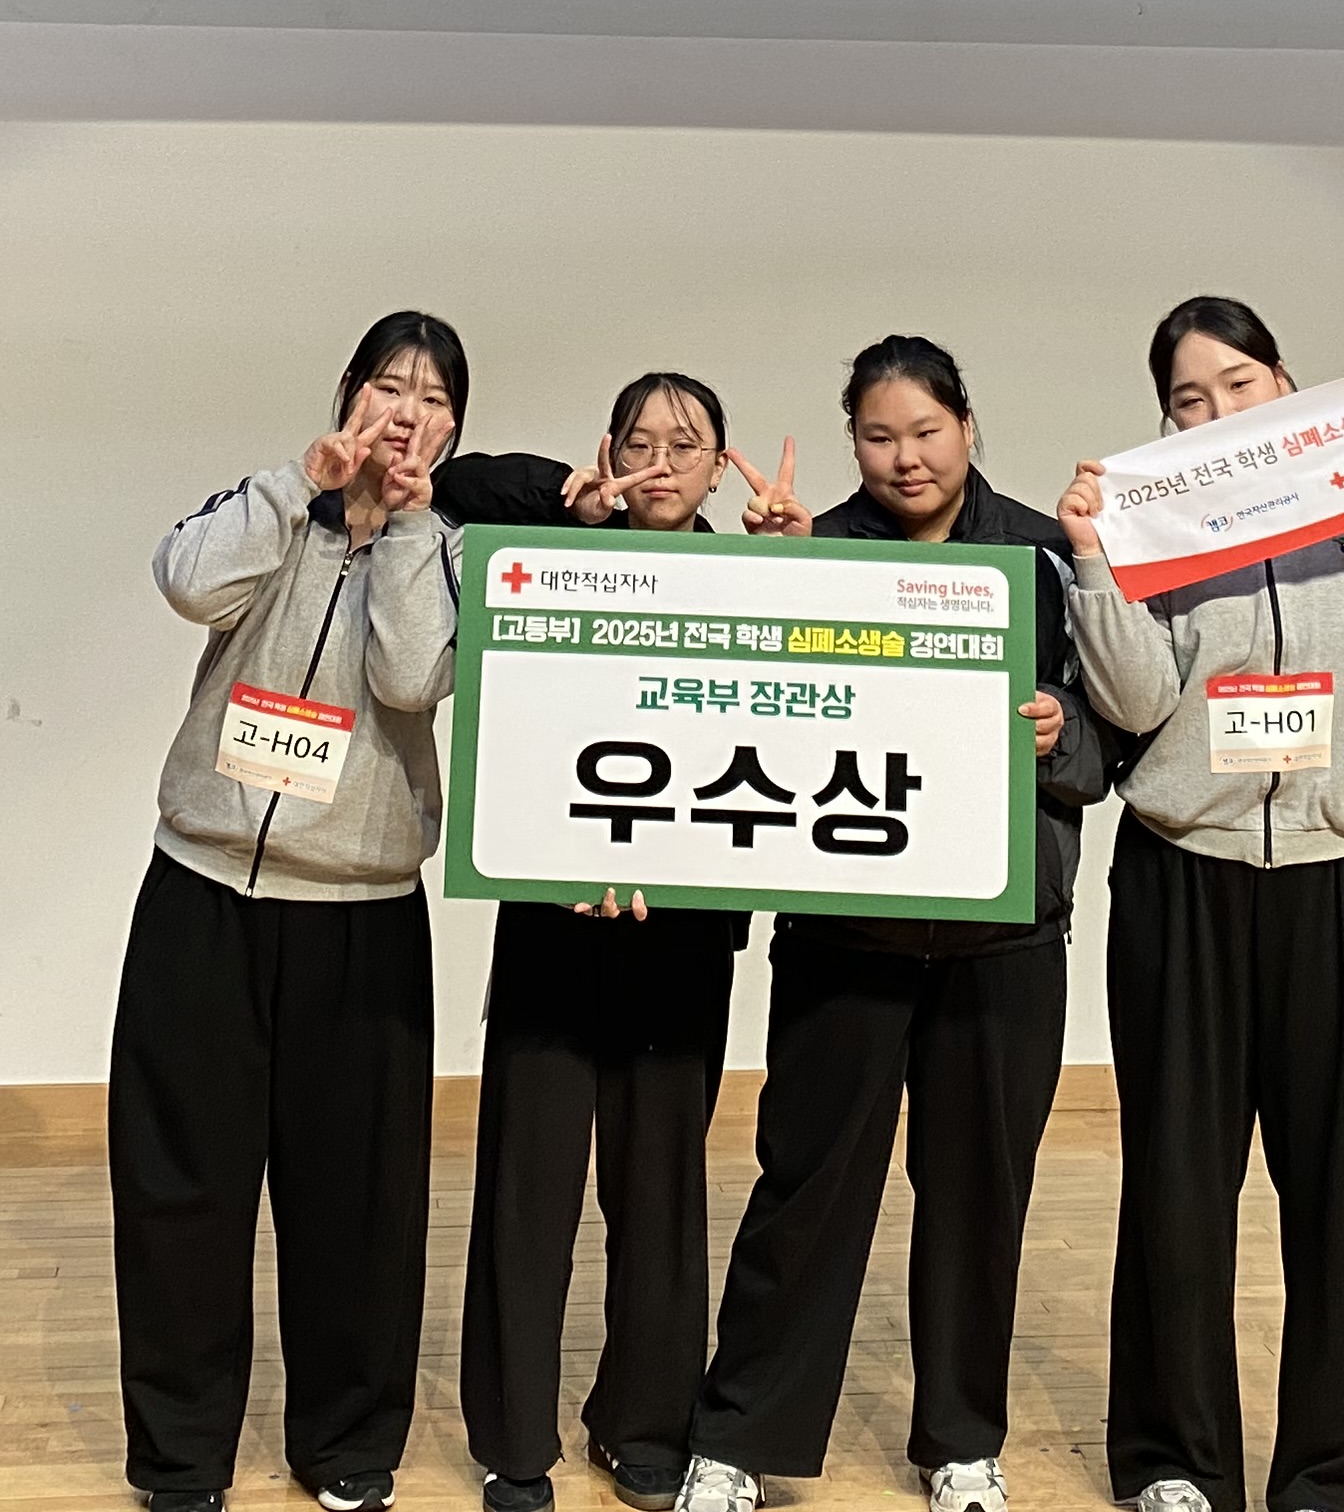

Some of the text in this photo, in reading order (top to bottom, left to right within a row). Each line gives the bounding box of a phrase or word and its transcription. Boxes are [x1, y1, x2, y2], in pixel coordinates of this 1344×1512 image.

[1115, 472, 1190, 511] 2025년
[1191, 456, 1233, 484] 전국
[1235, 442, 1280, 472] 학생
[541, 570, 656, 594] 대한적십자사
[897, 579, 947, 597] Saving
[897, 596, 994, 612] 적십자는 생명입니다.
[492, 614, 1004, 661] [고등부] 2025년 전국 학생 심폐소생술 경연대회
[636, 677, 856, 719] 교육부 장관상
[233, 720, 330, 763] 고-H04
[1225, 710, 1314, 734] 고-H01
[570, 741, 921, 856] 우수상
